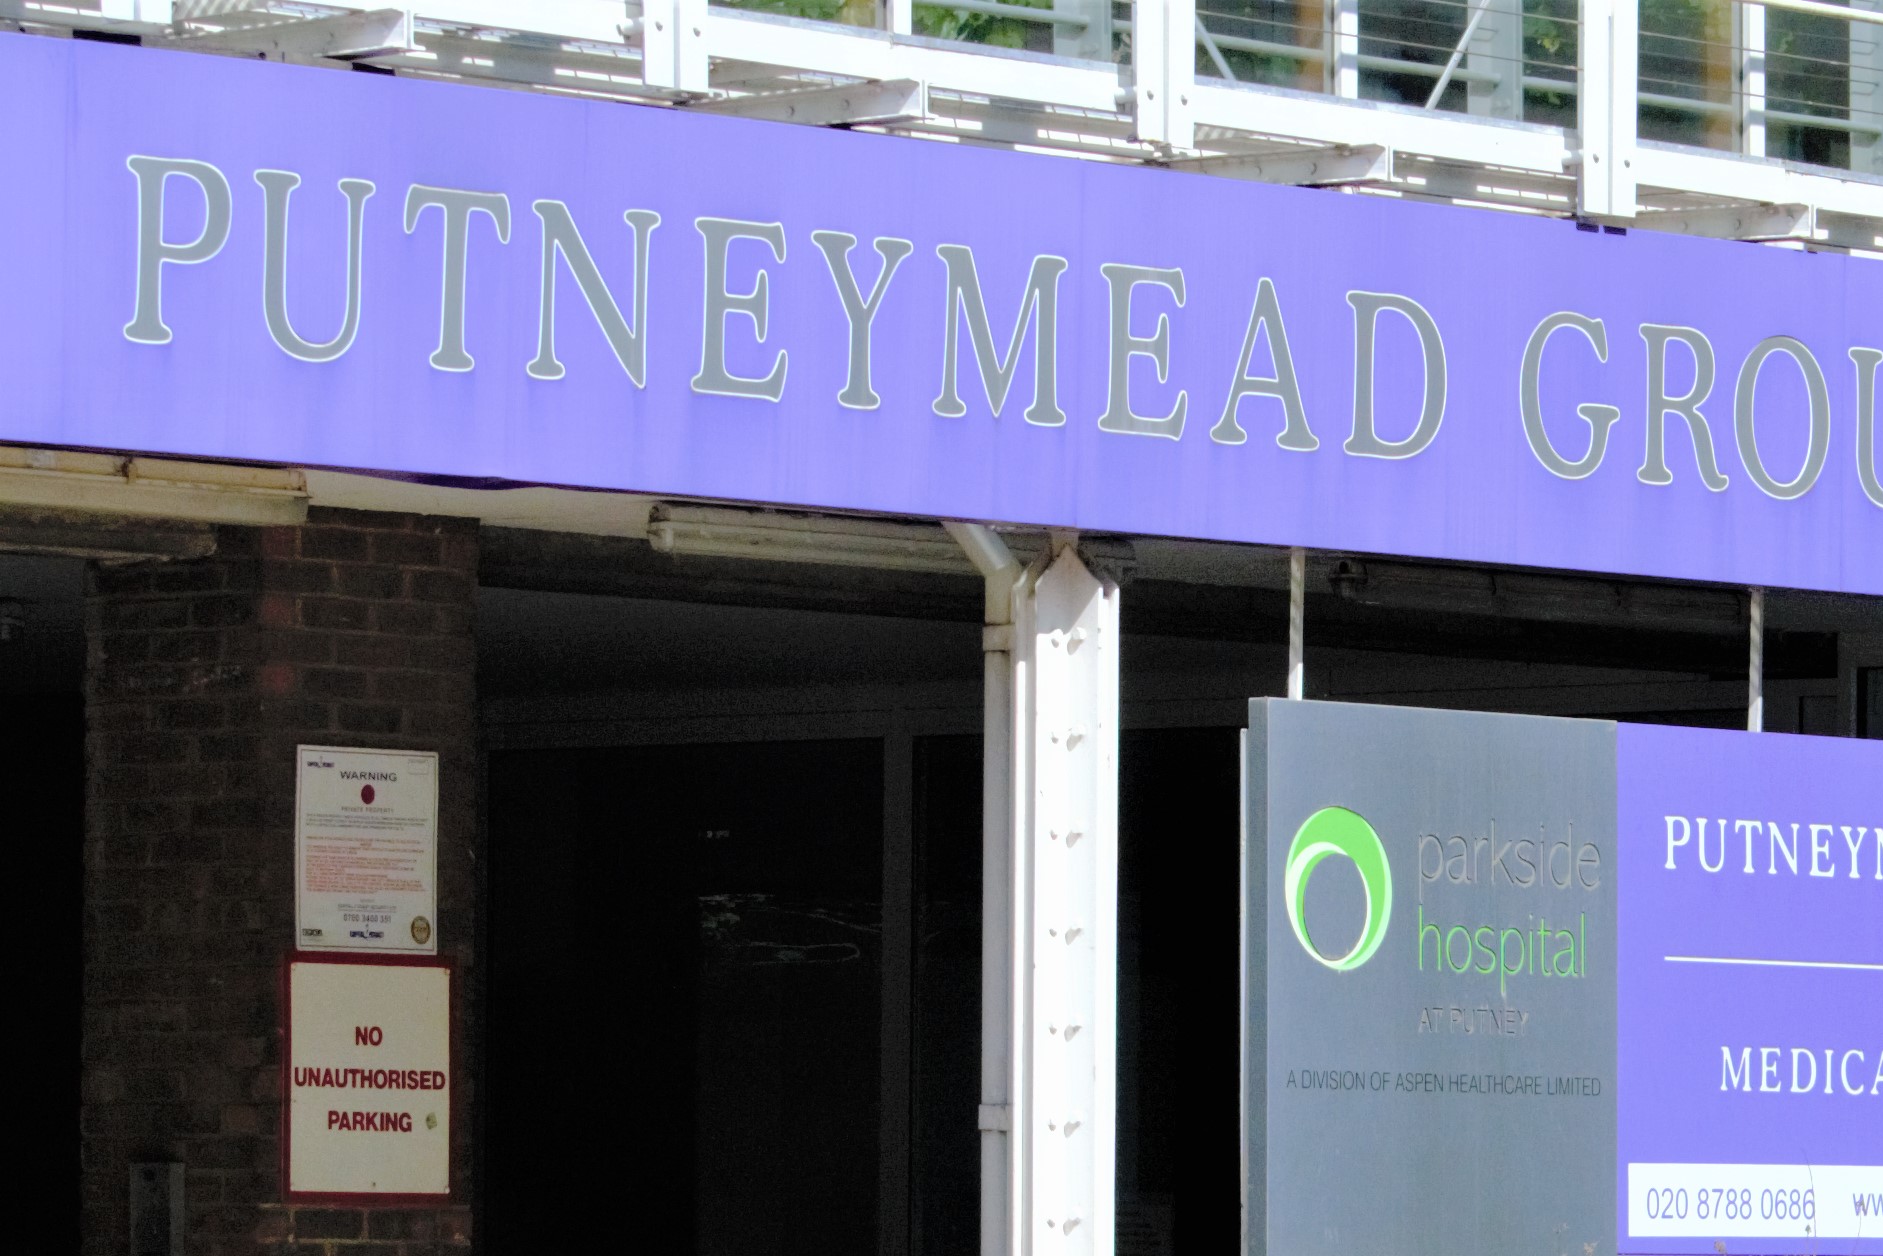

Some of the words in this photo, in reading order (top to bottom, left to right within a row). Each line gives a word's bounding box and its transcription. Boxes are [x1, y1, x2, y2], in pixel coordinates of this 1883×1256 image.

[122, 154, 1447, 460] PUTNEYMEAD
[340, 771, 398, 782] WARNING
[1418, 818, 1601, 904] parkside
[1419, 904, 1586, 998] hospital
[1418, 1007, 1443, 1034] AT
[1449, 1007, 1529, 1035] PUTNEY
[355, 1026, 383, 1046] NO
[294, 1067, 446, 1090] UNAUTHORISED
[1286, 1069, 1297, 1089] A
[1301, 1070, 1366, 1091] DIVISION
[1370, 1071, 1390, 1091] OF
[1395, 1072, 1444, 1093] ASPEN
[1449, 1074, 1542, 1095] HEALTHCARE
[1547, 1076, 1601, 1097] LIMITED
[327, 1110, 413, 1133] PARKING
[1646, 1187, 1689, 1221] 020
[1696, 1188, 1753, 1221] 8788
[1760, 1188, 1816, 1221] 0686
